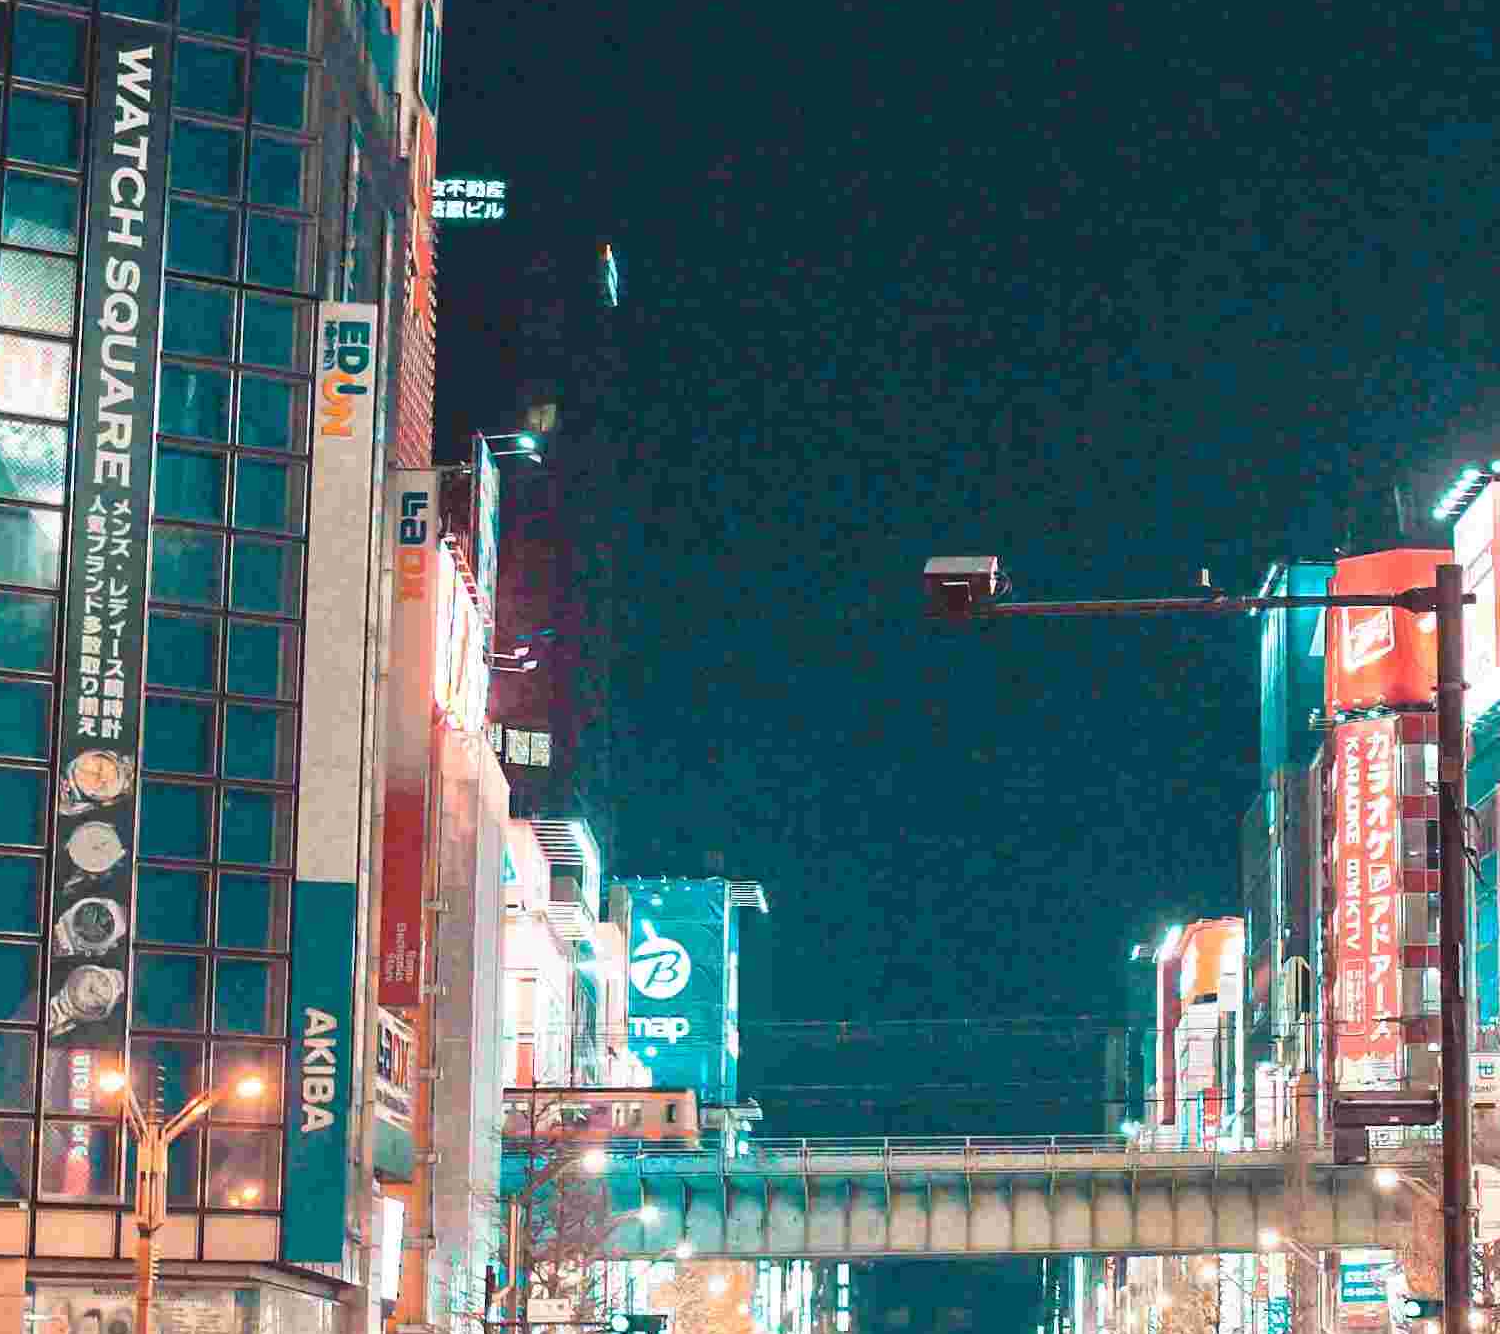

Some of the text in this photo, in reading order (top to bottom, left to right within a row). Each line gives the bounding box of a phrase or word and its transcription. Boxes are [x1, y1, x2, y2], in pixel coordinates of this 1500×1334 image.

[91, 45, 153, 488] WATCH SQUARE
[1346, 736, 1361, 844] KARAOKE
[301, 1006, 338, 1133] AKIBA
